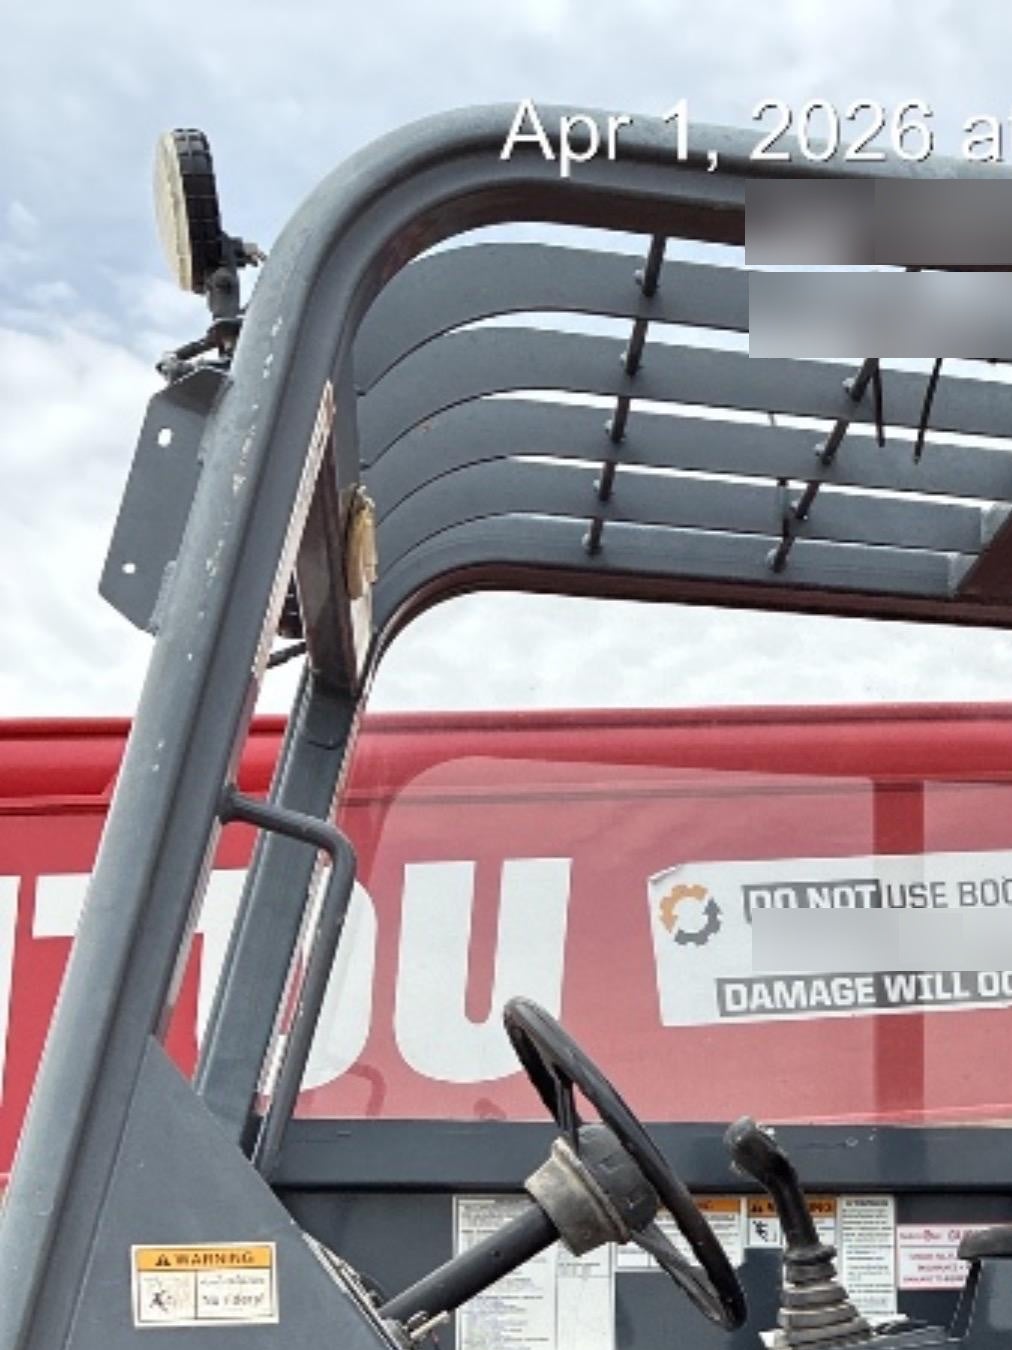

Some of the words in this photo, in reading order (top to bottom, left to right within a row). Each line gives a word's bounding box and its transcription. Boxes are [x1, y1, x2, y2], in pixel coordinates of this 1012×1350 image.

[806, 884, 877, 908] NOT
[885, 881, 949, 908] USE
[724, 976, 877, 1011] DAMAGE
[883, 971, 970, 1003] WILL
